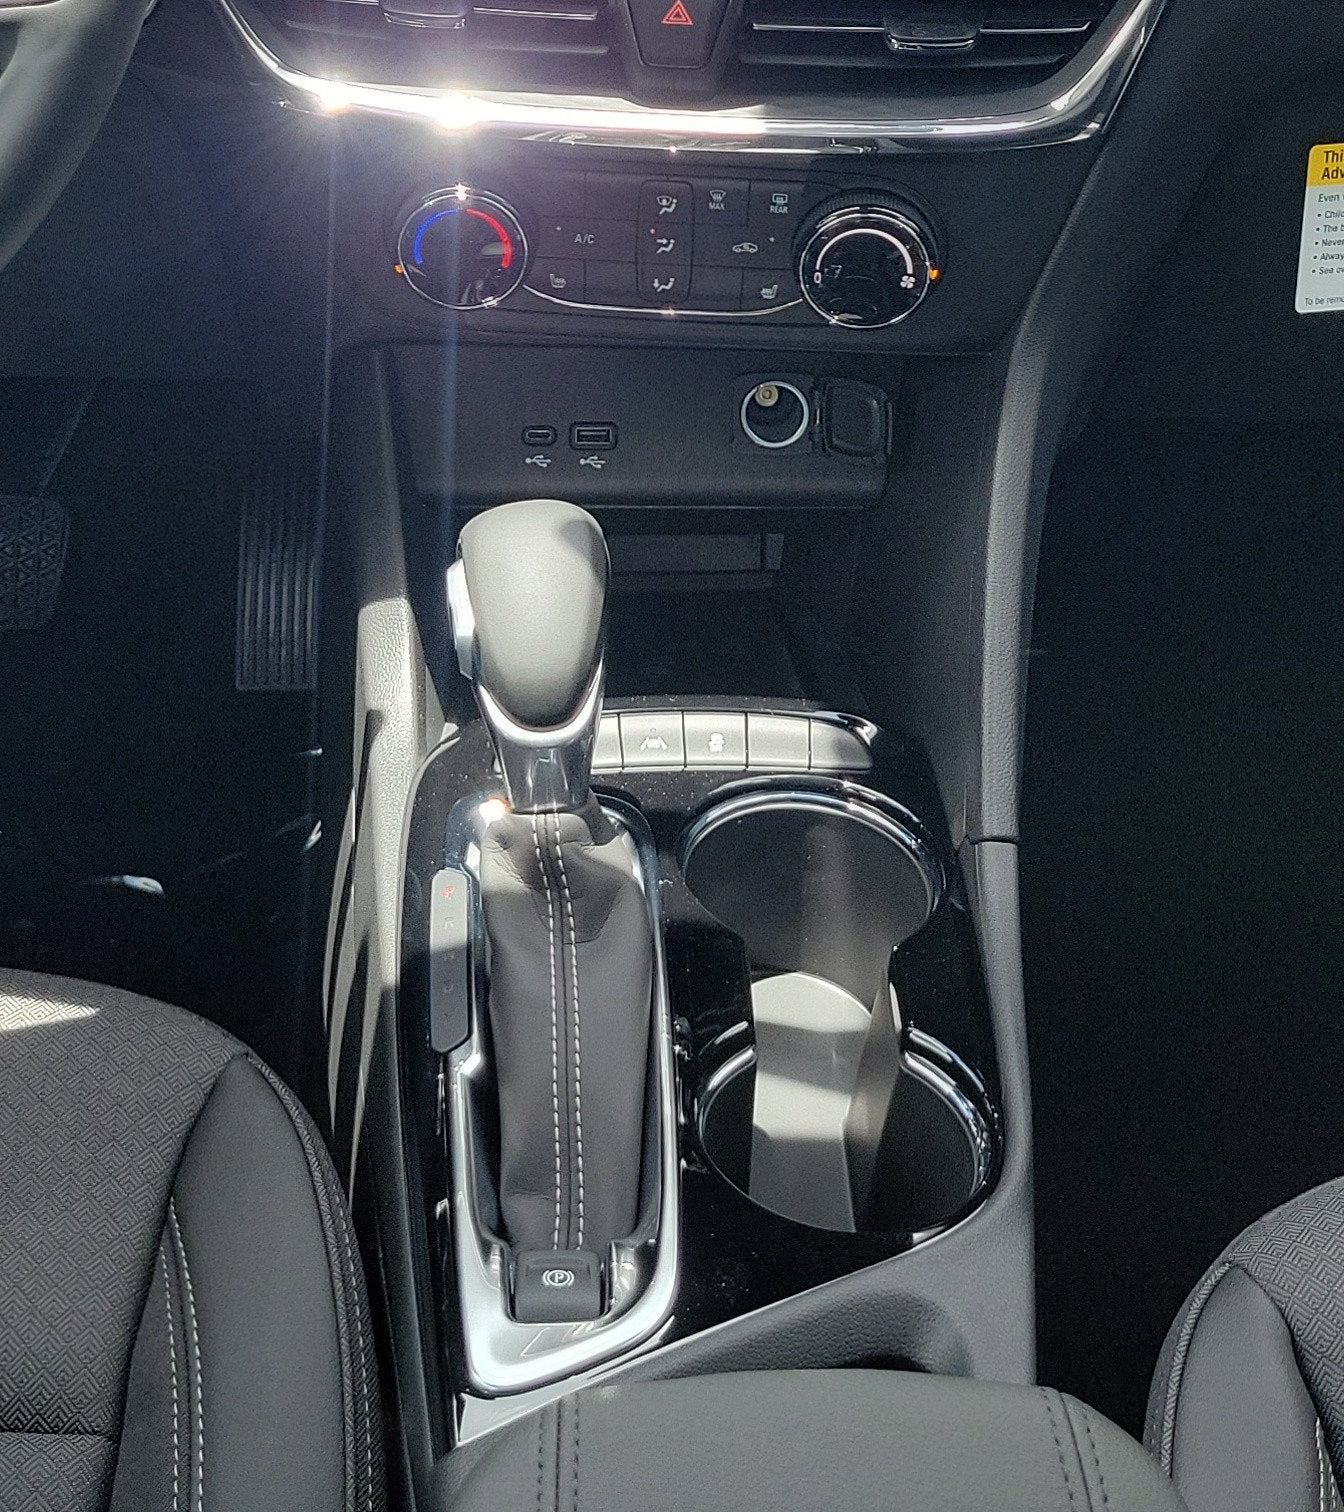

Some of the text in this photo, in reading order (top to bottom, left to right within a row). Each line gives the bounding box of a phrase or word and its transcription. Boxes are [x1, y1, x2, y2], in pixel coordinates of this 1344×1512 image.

[1318, 193, 1340, 203] Even
[709, 201, 725, 211] MAX
[770, 205, 788, 214] REAR
[1323, 224, 1338, 233] The
[574, 233, 595, 244] A/C
[1321, 239, 1344, 247] Never
[1318, 266, 1334, 275] See
[1305, 297, 1313, 306] To
